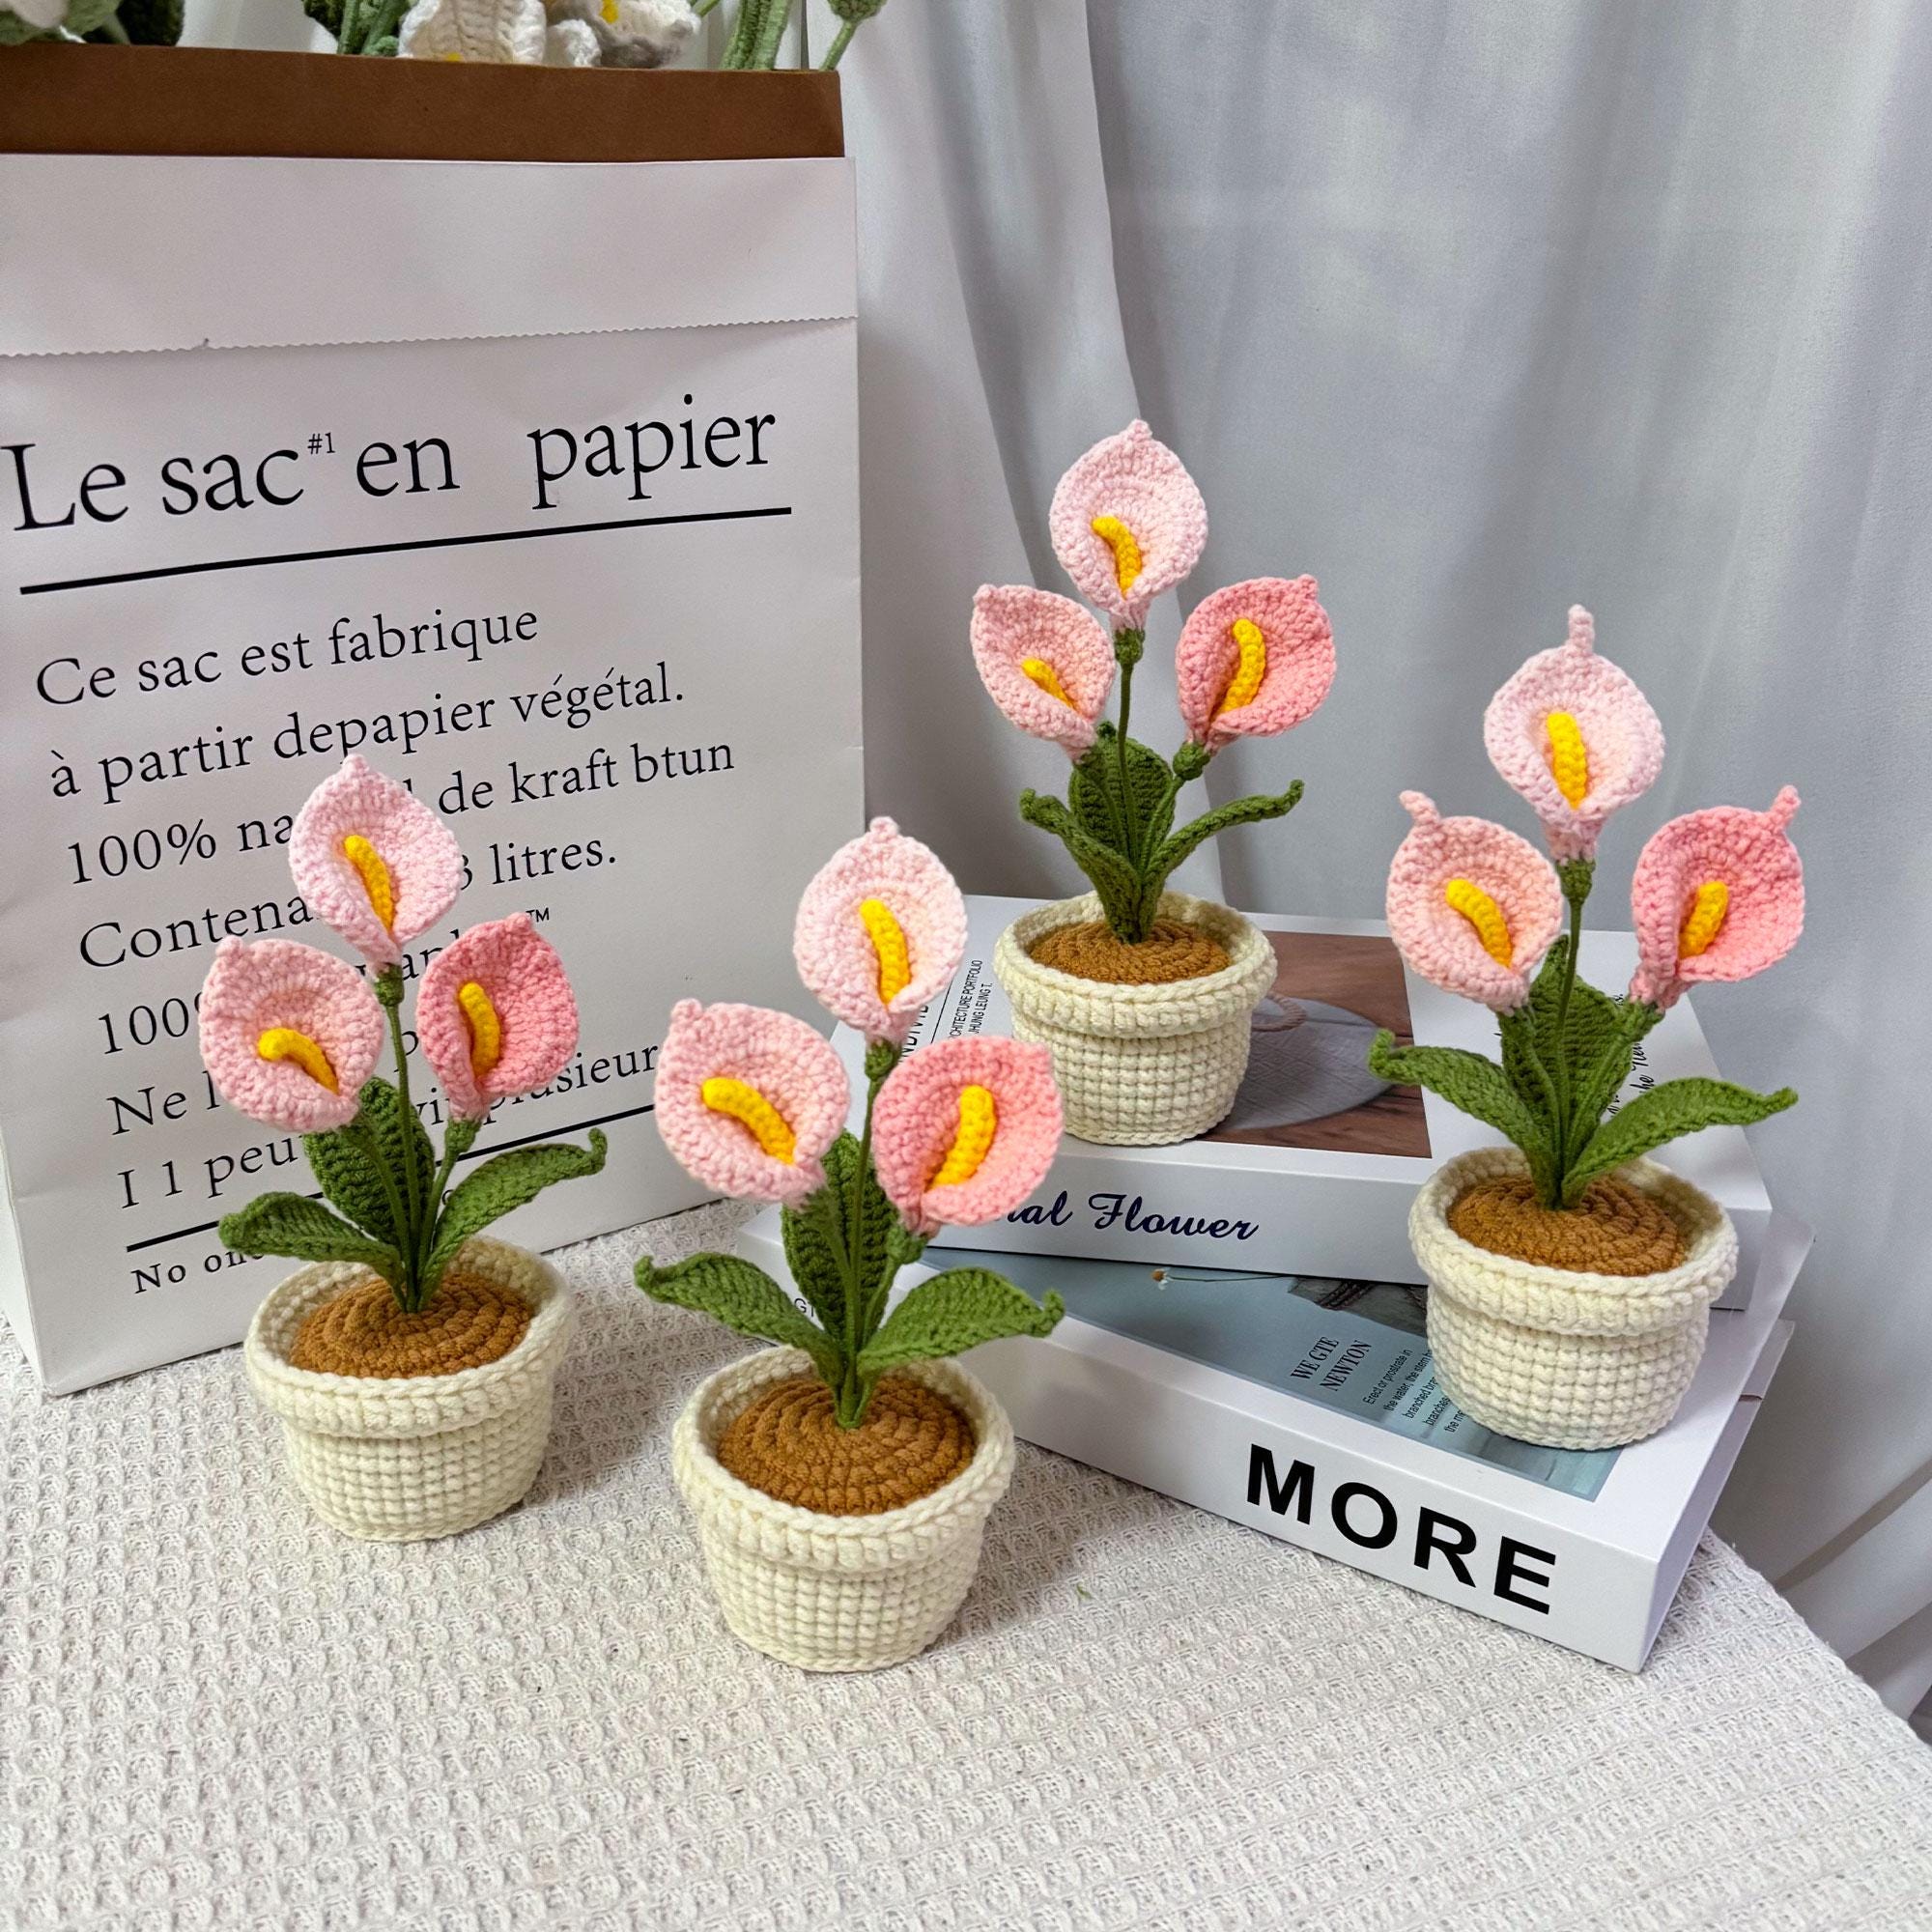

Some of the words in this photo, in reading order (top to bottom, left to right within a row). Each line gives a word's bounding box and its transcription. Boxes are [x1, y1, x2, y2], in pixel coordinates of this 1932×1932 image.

[1, 442, 129, 531] Le
[160, 448, 304, 516] sac
[355, 437, 461, 497] en
[526, 394, 776, 510] papier
[36, 657, 117, 705] Ce
[138, 649, 223, 692] sac
[241, 633, 314, 676] est
[328, 609, 538, 666] fabrique
[51, 750, 82, 798] à
[98, 725, 254, 805] partir
[273, 693, 496, 765] depapier
[510, 661, 684, 729] végétal.
[68, 818, 217, 885] 100%
[438, 771, 495, 815] de
[508, 748, 619, 804] kraft
[630, 743, 735, 783] btun
[80, 895, 315, 968] Contena
[489, 838, 616, 885] litres.
[99, 992, 202, 1055] 100
[949, 995, 973, 1037] CHITECTURE
[106, 1086, 187, 1136] Ne
[203, 1135, 303, 1200] peu
[1088, 1192, 1260, 1241] Flower
[130, 1263, 186, 1294] No
[1291, 1359, 1318, 1380] WE
[1308, 1336, 1340, 1365] GTE
[1320, 1340, 1373, 1392] NEWTON
[1362, 1385, 1383, 1405] Erect
[1382, 1354, 1407, 1381] prostrate
[1381, 1399, 1398, 1411] the
[1404, 1372, 1419, 1382] the
[1413, 1357, 1430, 1372] stem
[1402, 1389, 1430, 1418] branched
[1443, 1420, 1458, 1433] the
[1246, 1443, 1557, 1614] MORE
